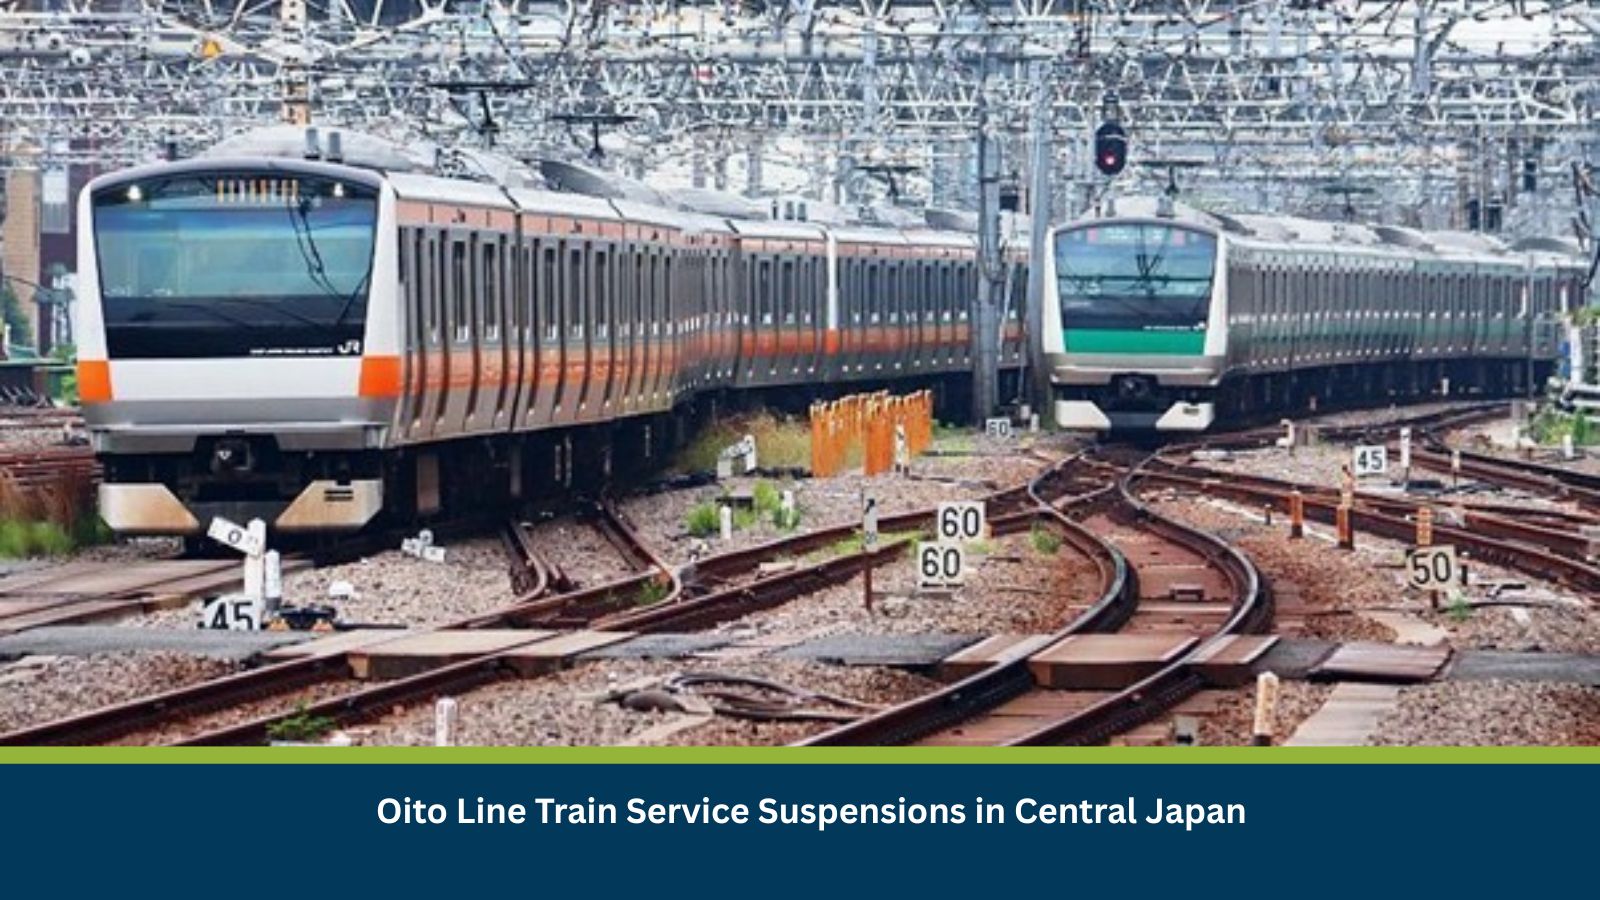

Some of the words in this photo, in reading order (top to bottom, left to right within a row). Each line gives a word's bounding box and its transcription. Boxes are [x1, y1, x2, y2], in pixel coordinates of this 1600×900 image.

[337, 340, 361, 354] JR
[1357, 450, 1383, 470] 45
[942, 506, 980, 538] 60
[921, 546, 960, 578] 60
[1412, 551, 1452, 585] 50
[210, 601, 253, 631] 45
